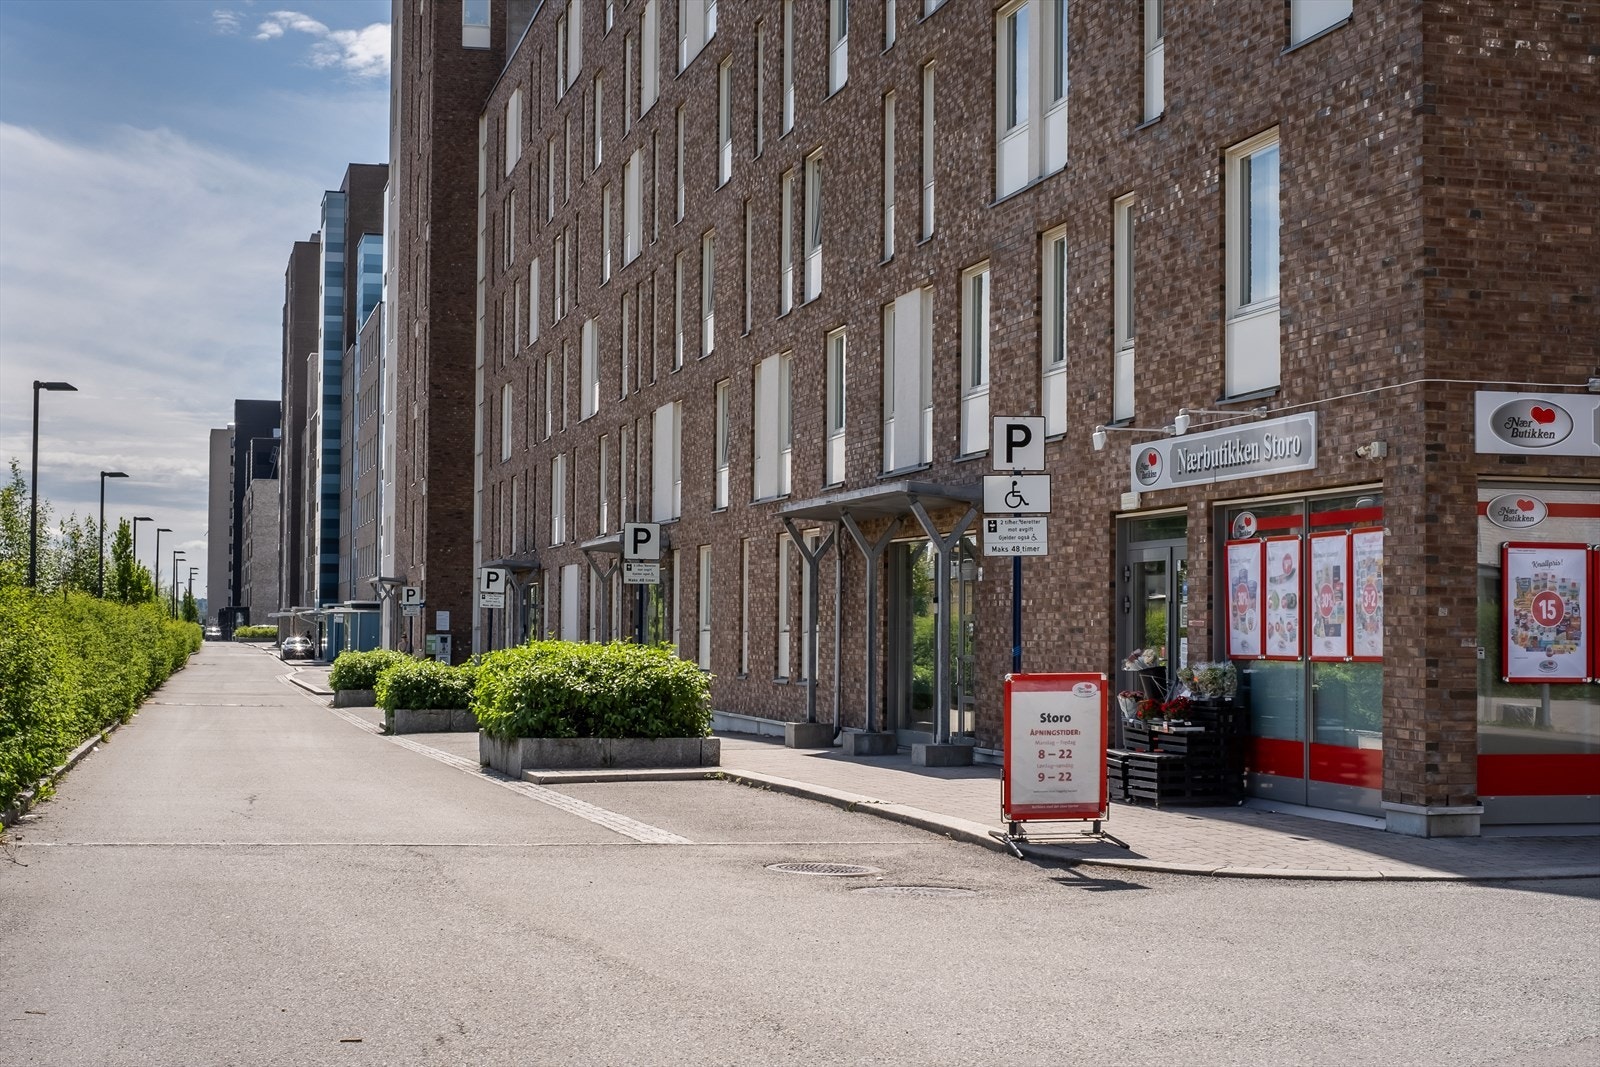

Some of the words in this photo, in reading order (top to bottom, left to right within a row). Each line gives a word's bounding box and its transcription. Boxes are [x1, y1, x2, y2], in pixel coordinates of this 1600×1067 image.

[1504, 417, 1533, 429] Nær
[1510, 428, 1555, 439] Butikken
[1006, 424, 1032, 463] P
[1177, 437, 1260, 475] Nærbutikken
[1263, 432, 1302, 461] Storo
[1498, 507, 1518, 516] Nær
[1502, 514, 1535, 522] Butikken
[633, 527, 651, 554] P
[487, 571, 499, 589] P
[406, 589, 416, 602] P
[1539, 600, 1557, 619] 15
[1040, 713, 1071, 723] Storo
[1038, 749, 1045, 759] 8
[1058, 749, 1072, 759] 22
[1038, 773, 1045, 782] 9
[1058, 772, 1072, 782] 22
